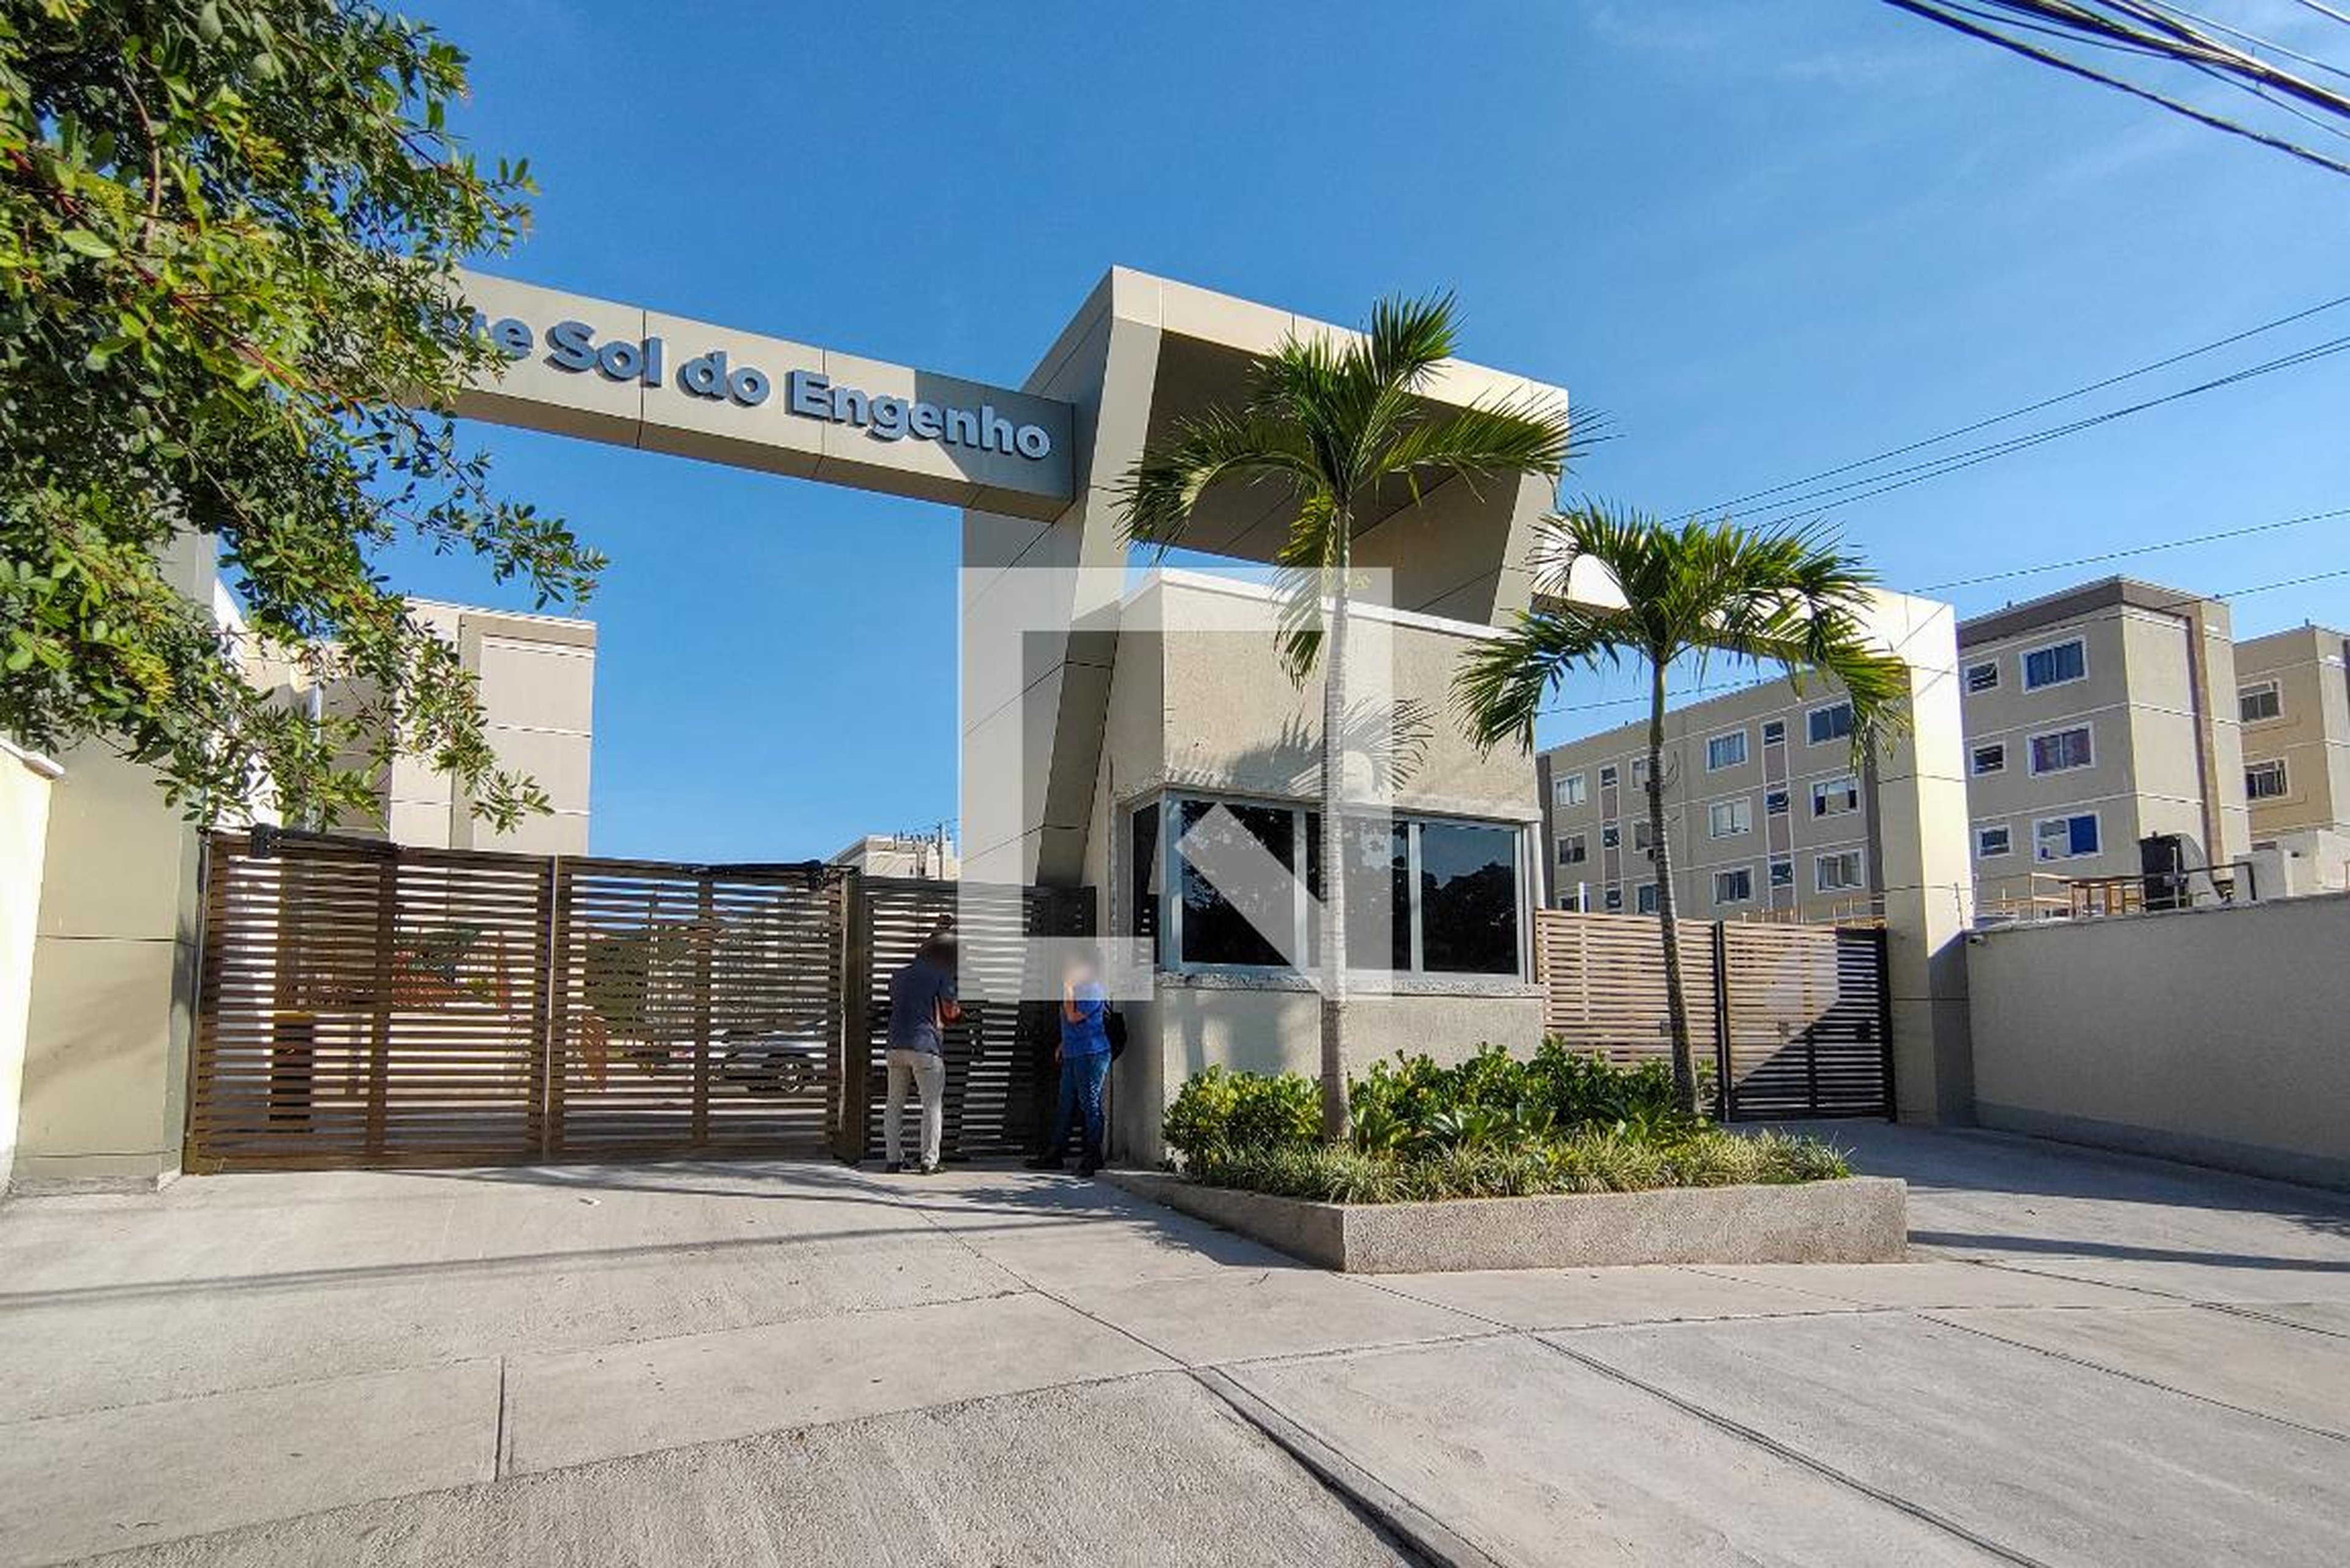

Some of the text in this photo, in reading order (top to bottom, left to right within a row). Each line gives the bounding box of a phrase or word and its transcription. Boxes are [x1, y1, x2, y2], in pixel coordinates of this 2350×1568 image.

[545, 320, 663, 388] Sol
[677, 351, 770, 406] do
[785, 369, 1051, 458] Engenho
